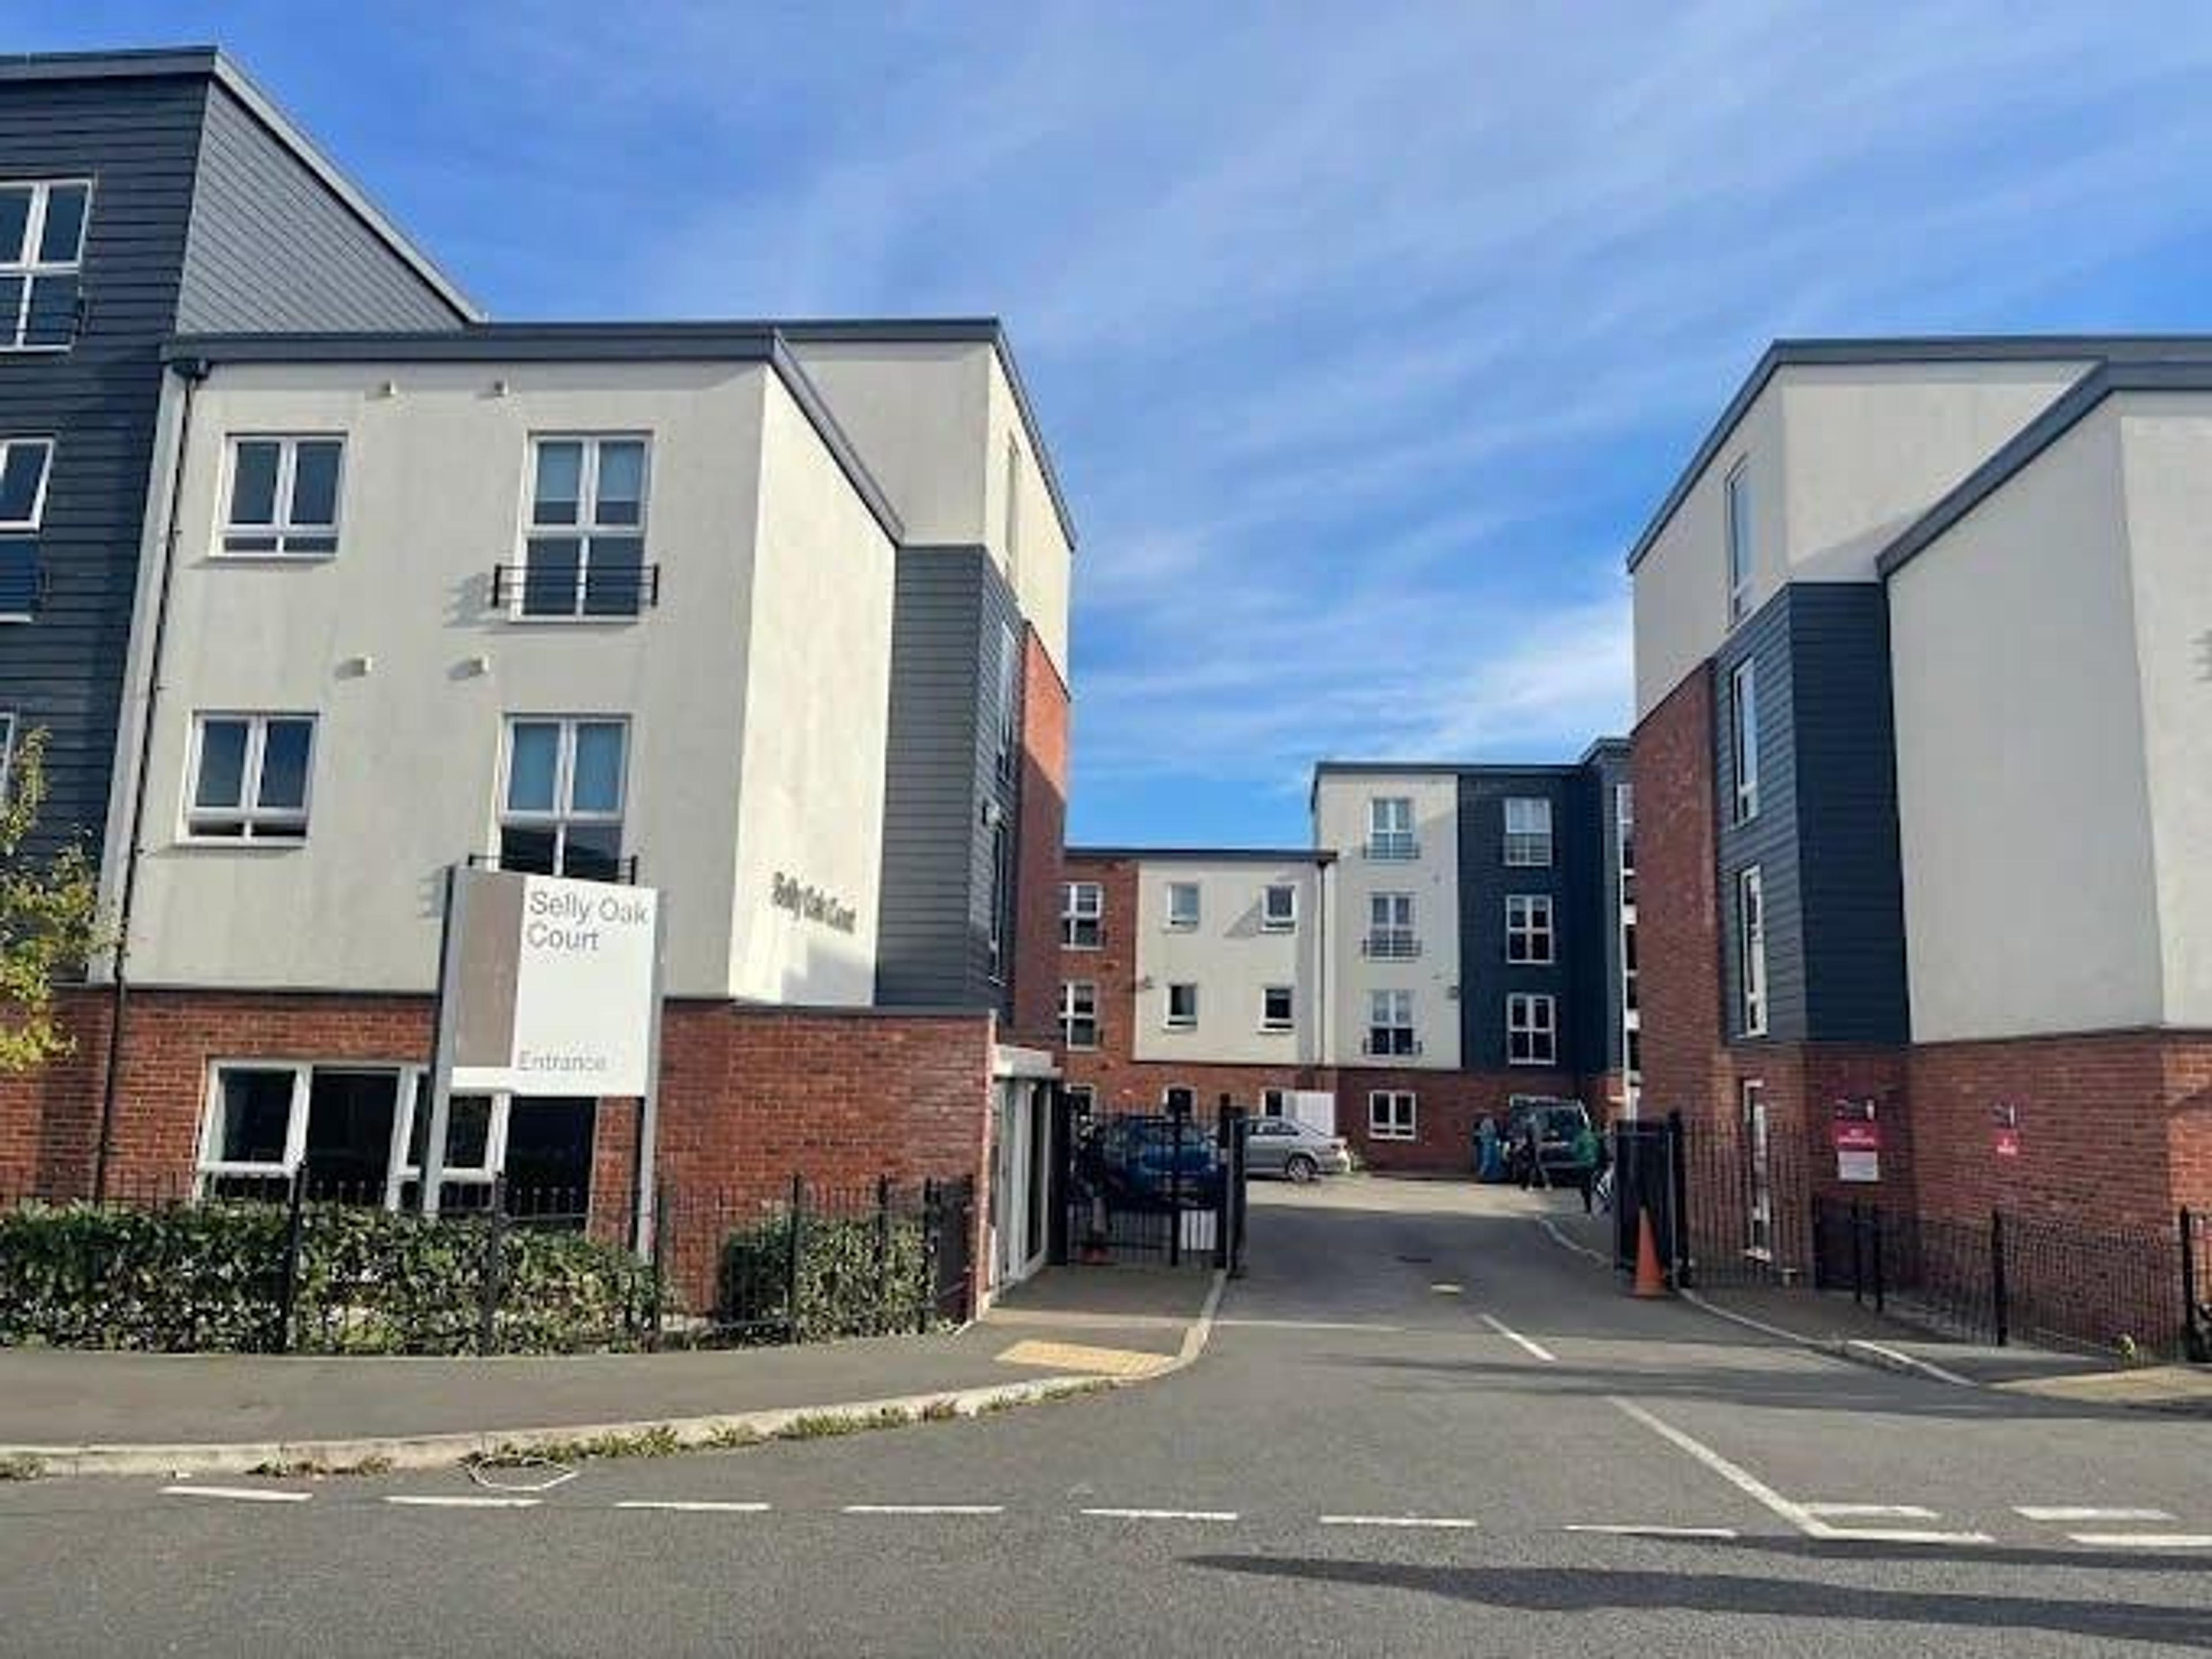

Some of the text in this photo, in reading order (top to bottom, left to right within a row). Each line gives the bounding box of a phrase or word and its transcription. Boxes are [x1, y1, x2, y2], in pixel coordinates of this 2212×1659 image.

[529, 891, 648, 926] Selly Oak
[527, 922, 599, 950] Court
[518, 1051, 607, 1071] Entrance
